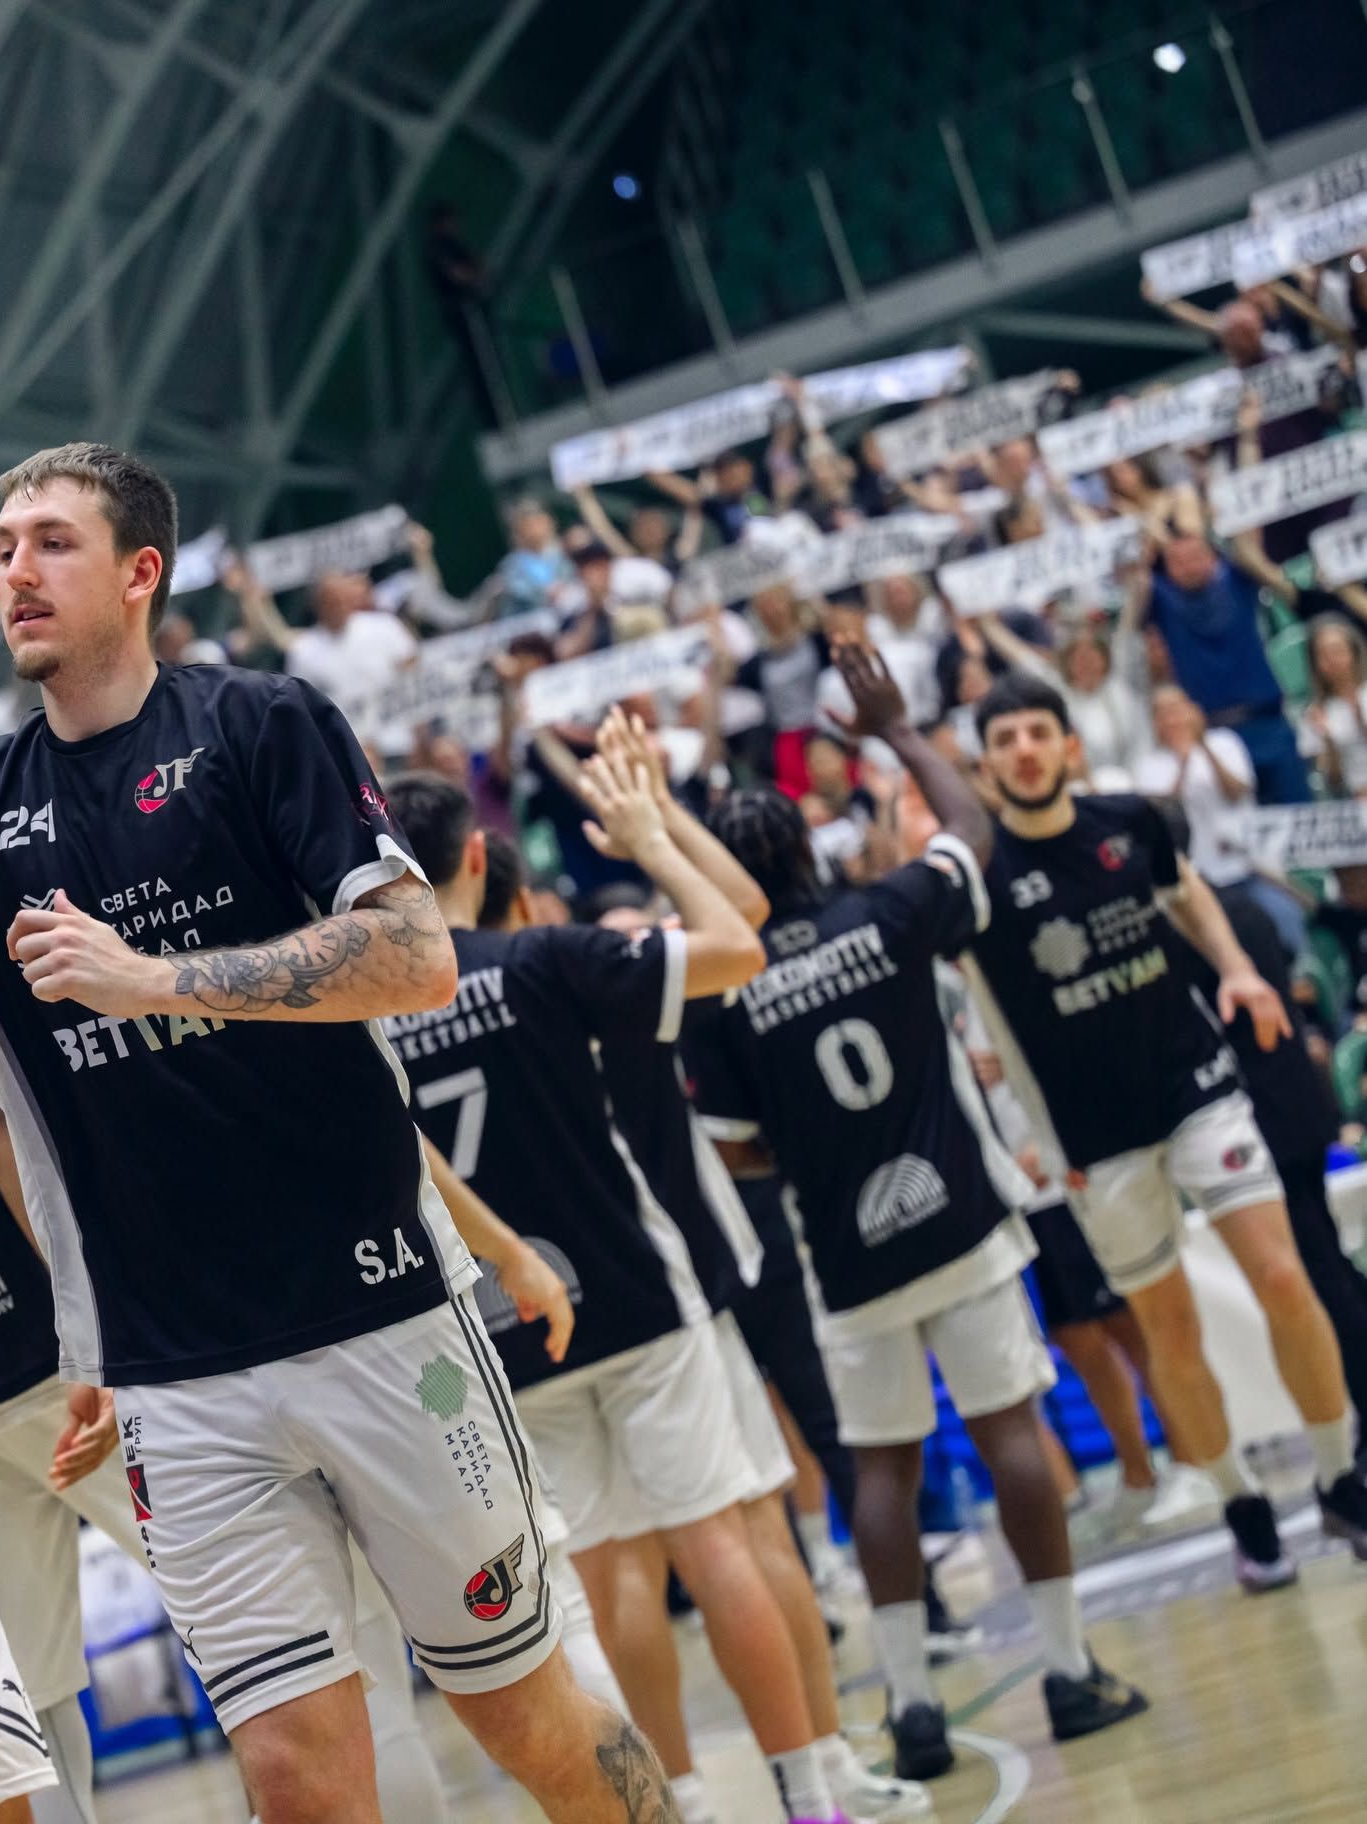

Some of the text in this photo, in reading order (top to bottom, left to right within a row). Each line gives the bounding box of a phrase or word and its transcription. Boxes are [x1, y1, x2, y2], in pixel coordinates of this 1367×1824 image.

[0, 798, 56, 850] 24
[100, 877, 171, 914] СВЕТА
[1010, 870, 1053, 909] 33
[814, 1017, 895, 1111] 0
[416, 1066, 489, 1180] 7
[354, 1228, 424, 1285] S.A.
[134, 1416, 142, 1453] ГРУП
[467, 1420, 492, 1474] СВЕТА
[444, 1433, 475, 1493] МБАЛ
[456, 1426, 494, 1510] КАРИДАД
